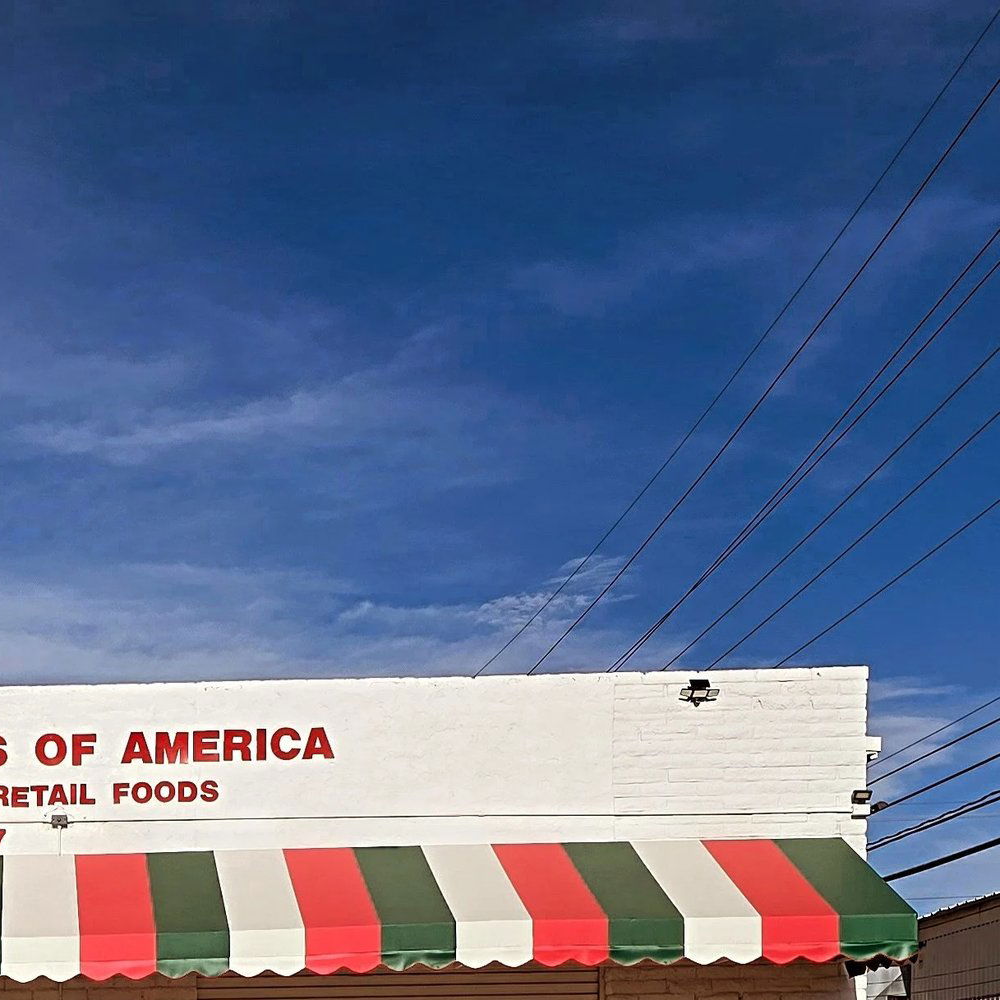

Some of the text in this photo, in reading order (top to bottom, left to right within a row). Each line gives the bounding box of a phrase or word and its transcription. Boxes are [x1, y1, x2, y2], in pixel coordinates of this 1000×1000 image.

[35, 733, 97, 766] OF
[121, 727, 335, 764] AMERICA
[113, 780, 219, 804] FOODS
